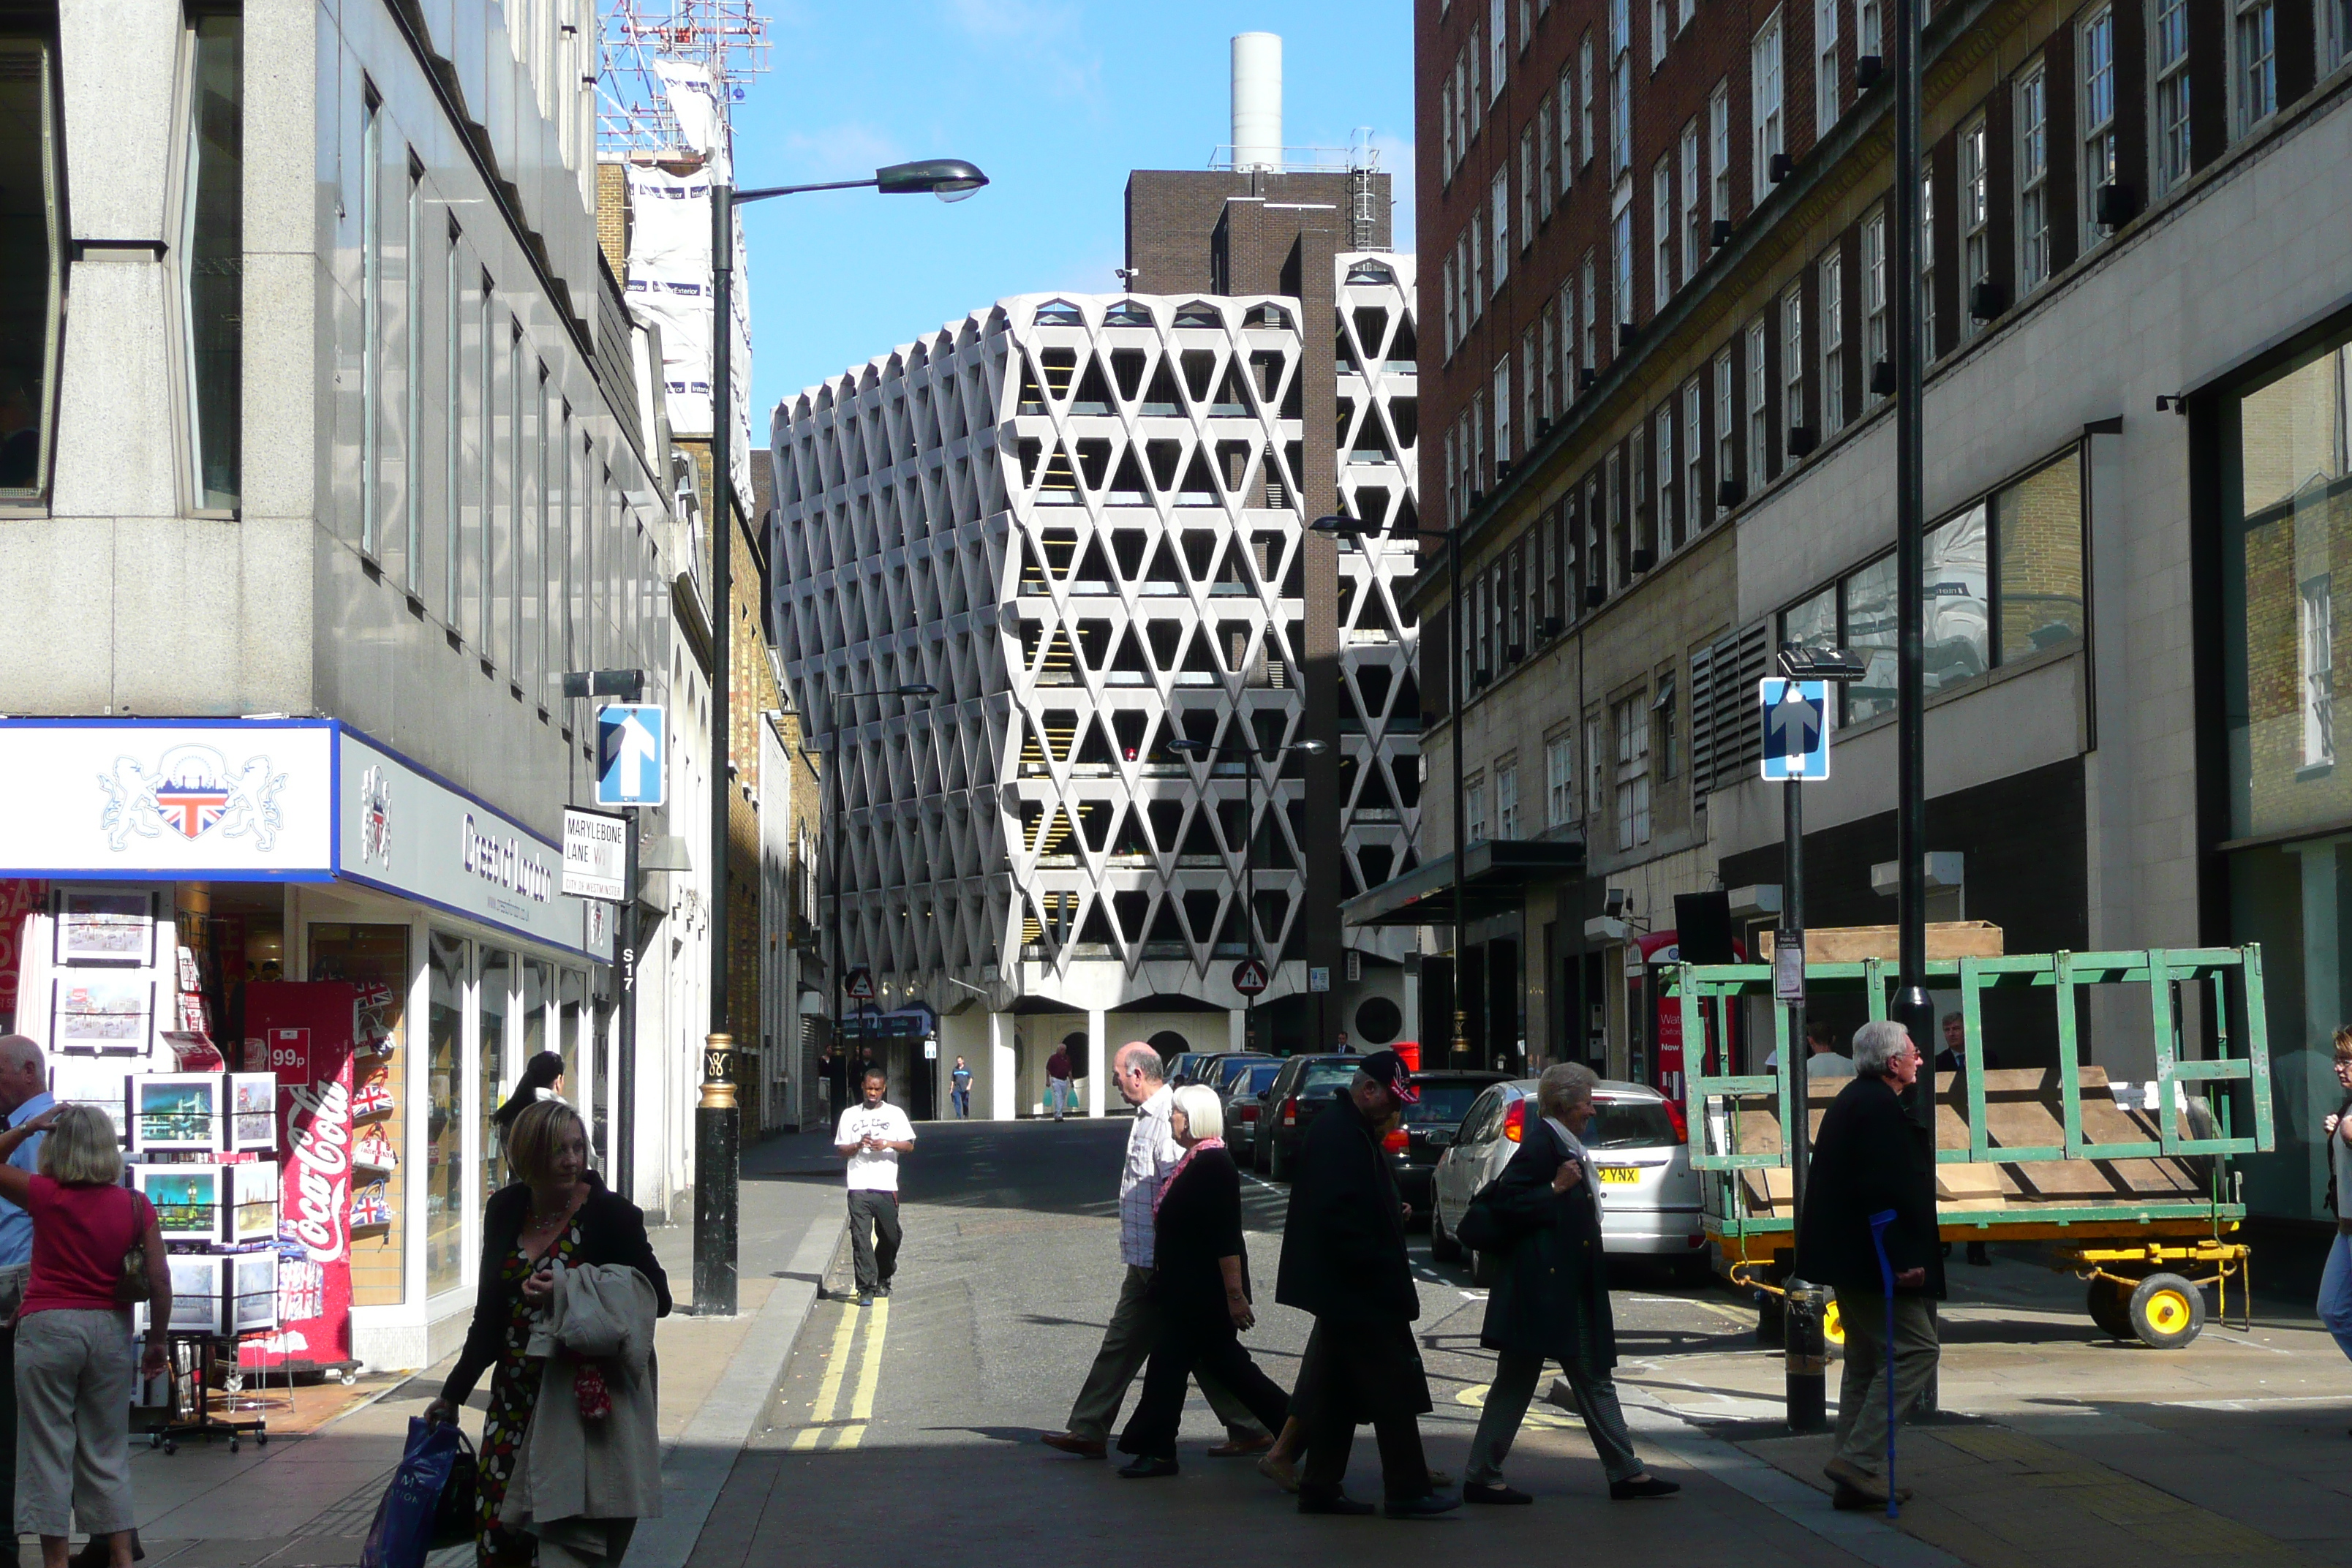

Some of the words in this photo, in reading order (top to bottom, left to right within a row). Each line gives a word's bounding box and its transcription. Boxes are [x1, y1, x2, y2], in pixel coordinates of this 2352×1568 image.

[568, 818, 622, 843] MARYLEBONE
[463, 813, 499, 883] Crest
[500, 837, 514, 888] of
[514, 840, 551, 904] London
[567, 842, 588, 862] LANE
[566, 878, 577, 890] CITY
[578, 881, 584, 891] OF
[586, 882, 621, 897] WESTMINSTER
[623, 948, 634, 990] S17
[1661, 1043, 1680, 1052] Now
[272, 1049, 306, 1068] 99p
[361, 1146, 395, 1159] ENGLAND
[1610, 1168, 1635, 1182] YNX
